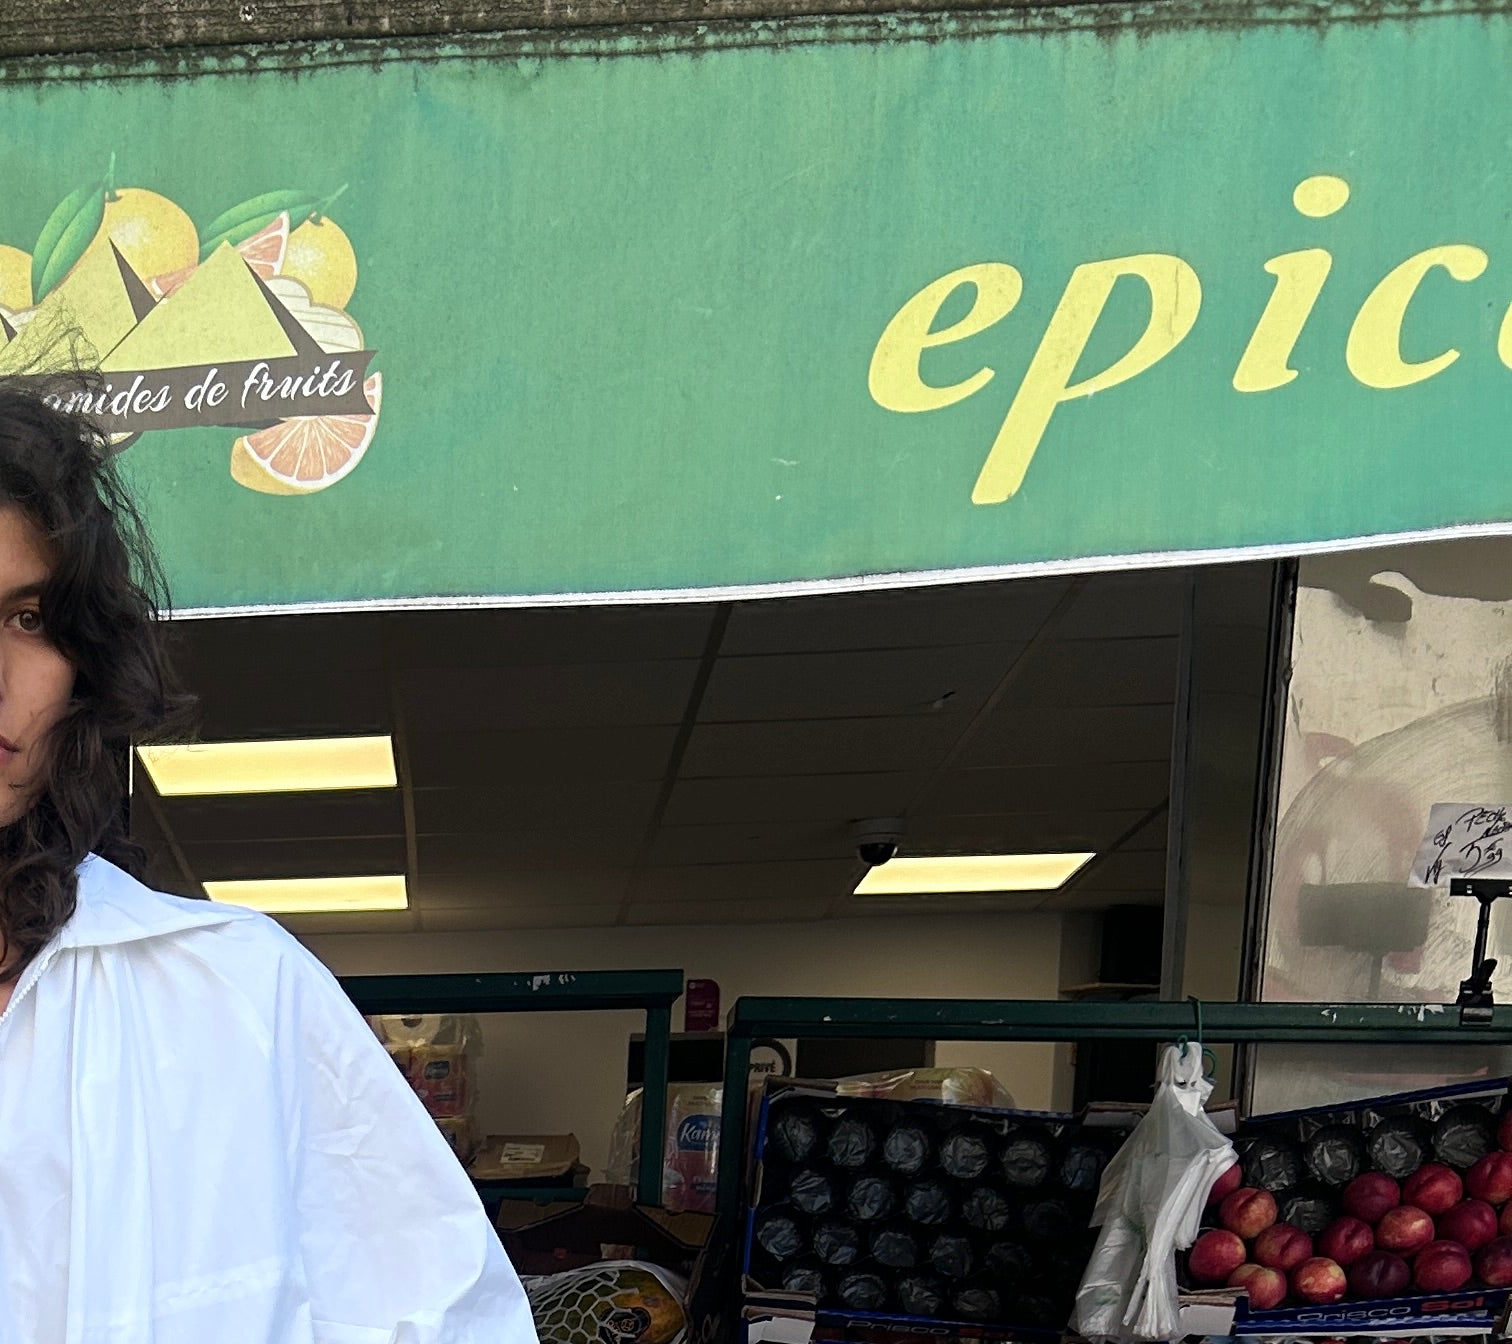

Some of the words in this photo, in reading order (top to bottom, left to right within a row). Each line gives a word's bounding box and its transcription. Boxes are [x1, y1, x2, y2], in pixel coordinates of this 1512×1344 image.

[868, 175, 1512, 504] epic
[41, 375, 172, 419] amides
[184, 367, 229, 413] de
[241, 360, 357, 409] fruits
[1421, 1297, 1485, 1312] Sol
